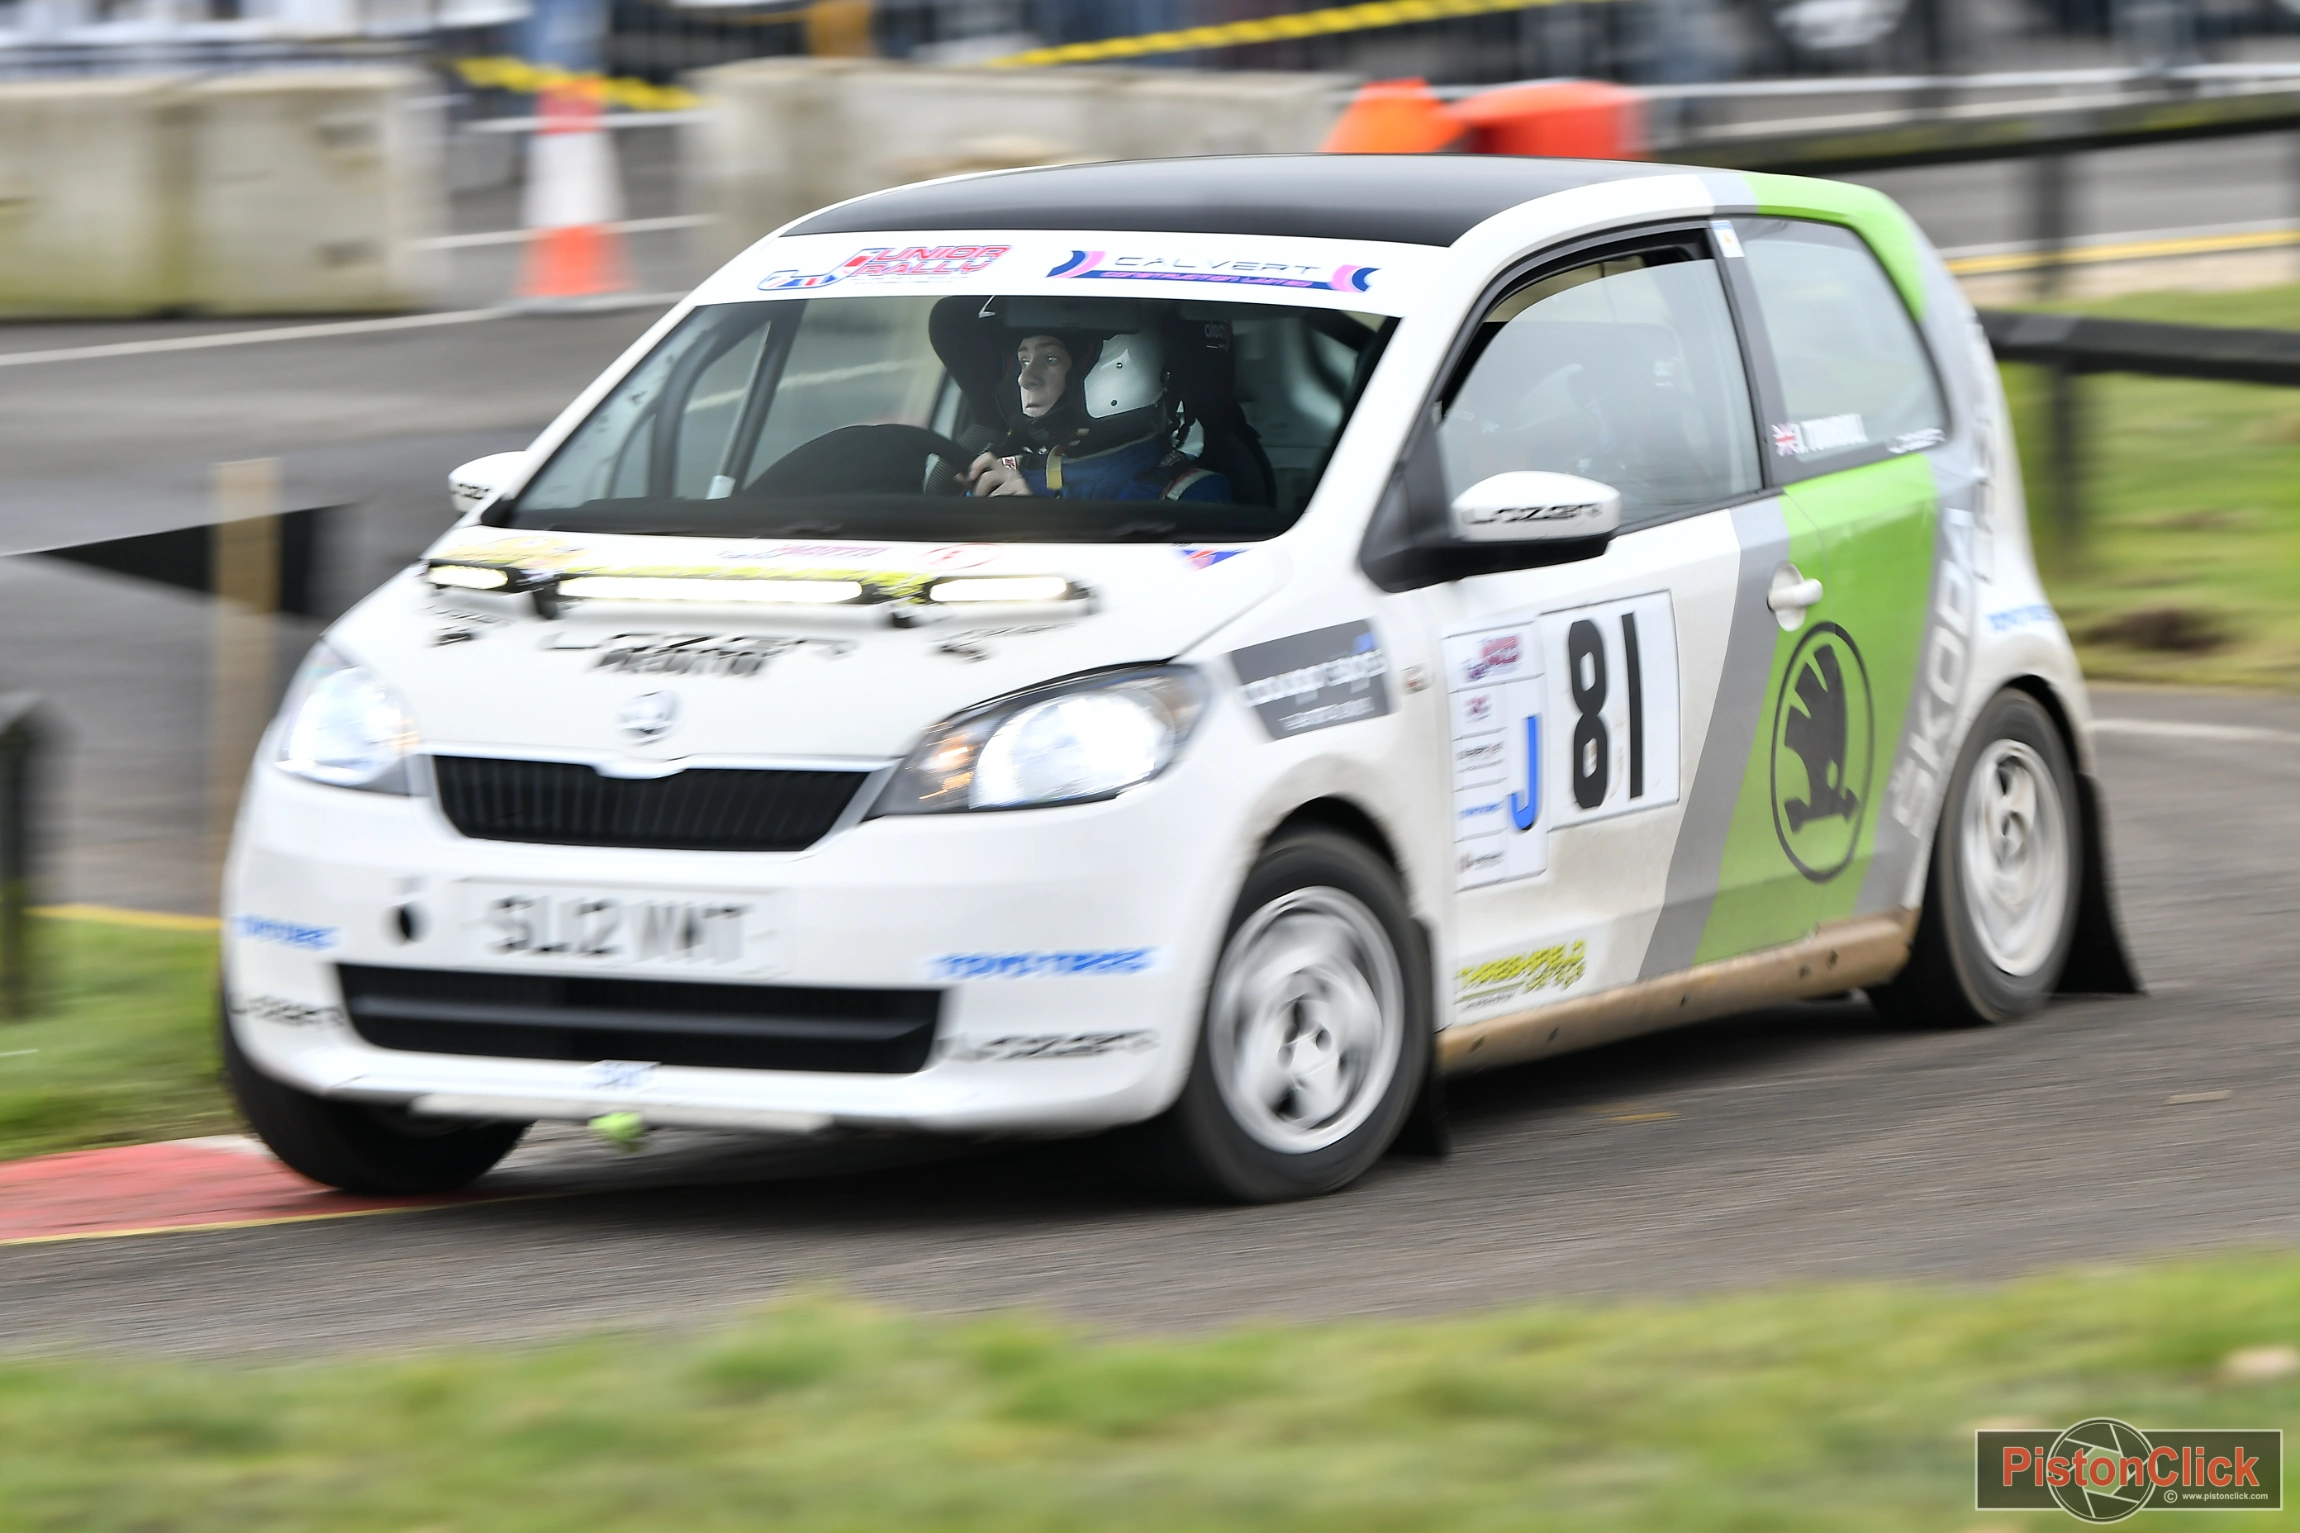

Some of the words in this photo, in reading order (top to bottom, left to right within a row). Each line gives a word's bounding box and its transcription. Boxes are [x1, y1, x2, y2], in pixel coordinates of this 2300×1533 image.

[850, 260, 992, 277] RALLY
[1113, 256, 1321, 275] CALVERT
[1568, 611, 1644, 810] 81
[1509, 713, 1541, 830] J
